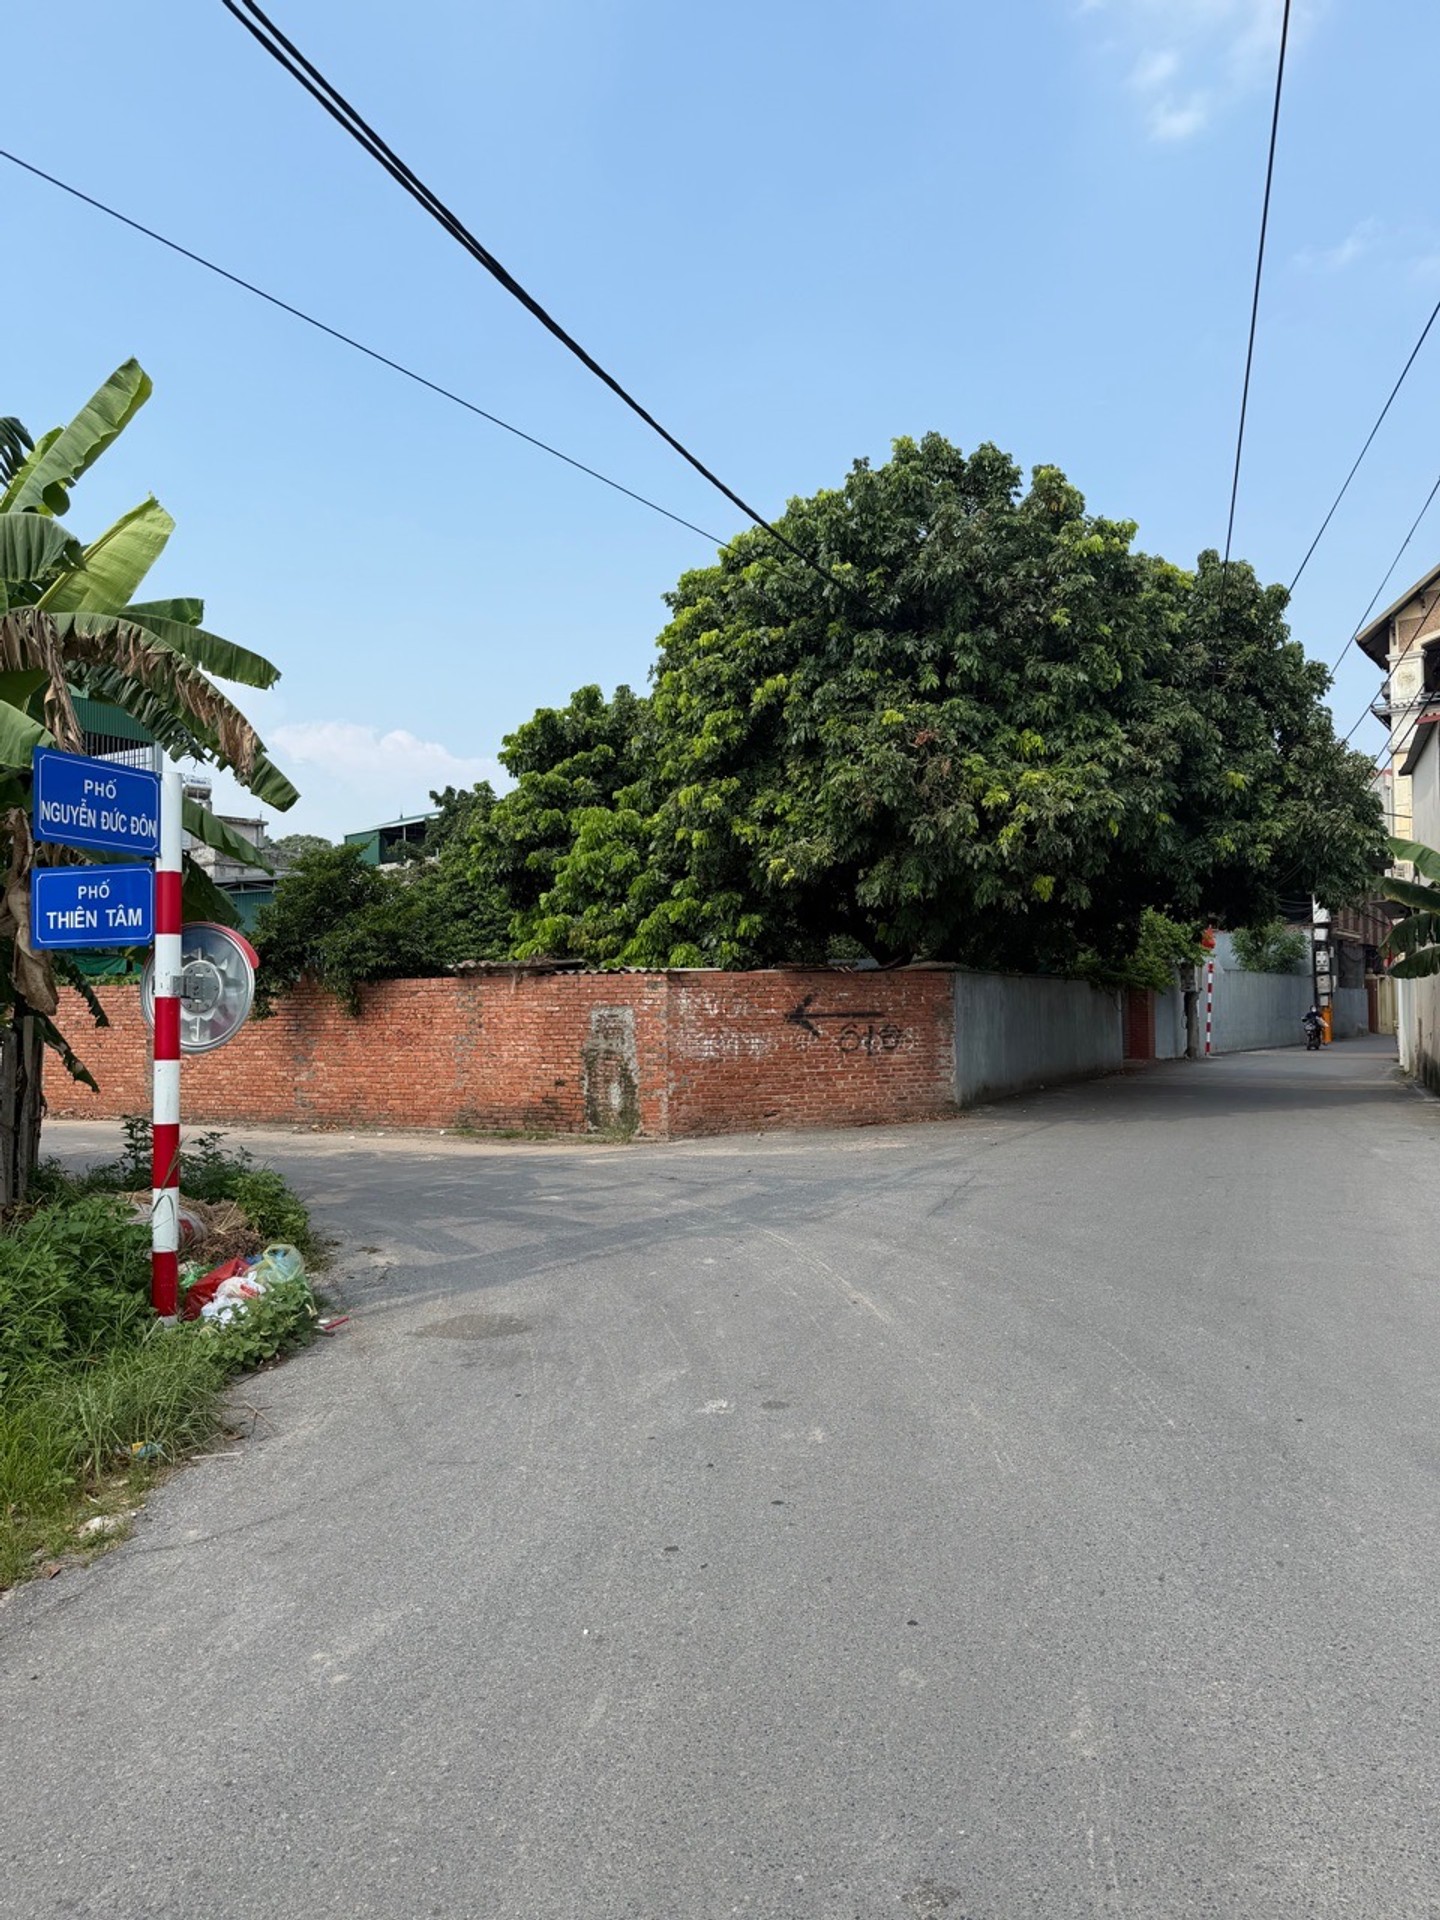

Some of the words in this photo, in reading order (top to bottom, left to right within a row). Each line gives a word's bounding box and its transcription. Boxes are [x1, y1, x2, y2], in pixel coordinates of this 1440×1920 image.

[83, 779, 117, 799] PHỐ
[41, 798, 97, 829] NGUYỄN
[100, 808, 128, 833] ĐỨC
[129, 814, 157, 839] ĐÔN
[78, 878, 110, 899] PHỐ
[46, 906, 98, 930] THIÊN
[105, 904, 143, 927] TÂM
